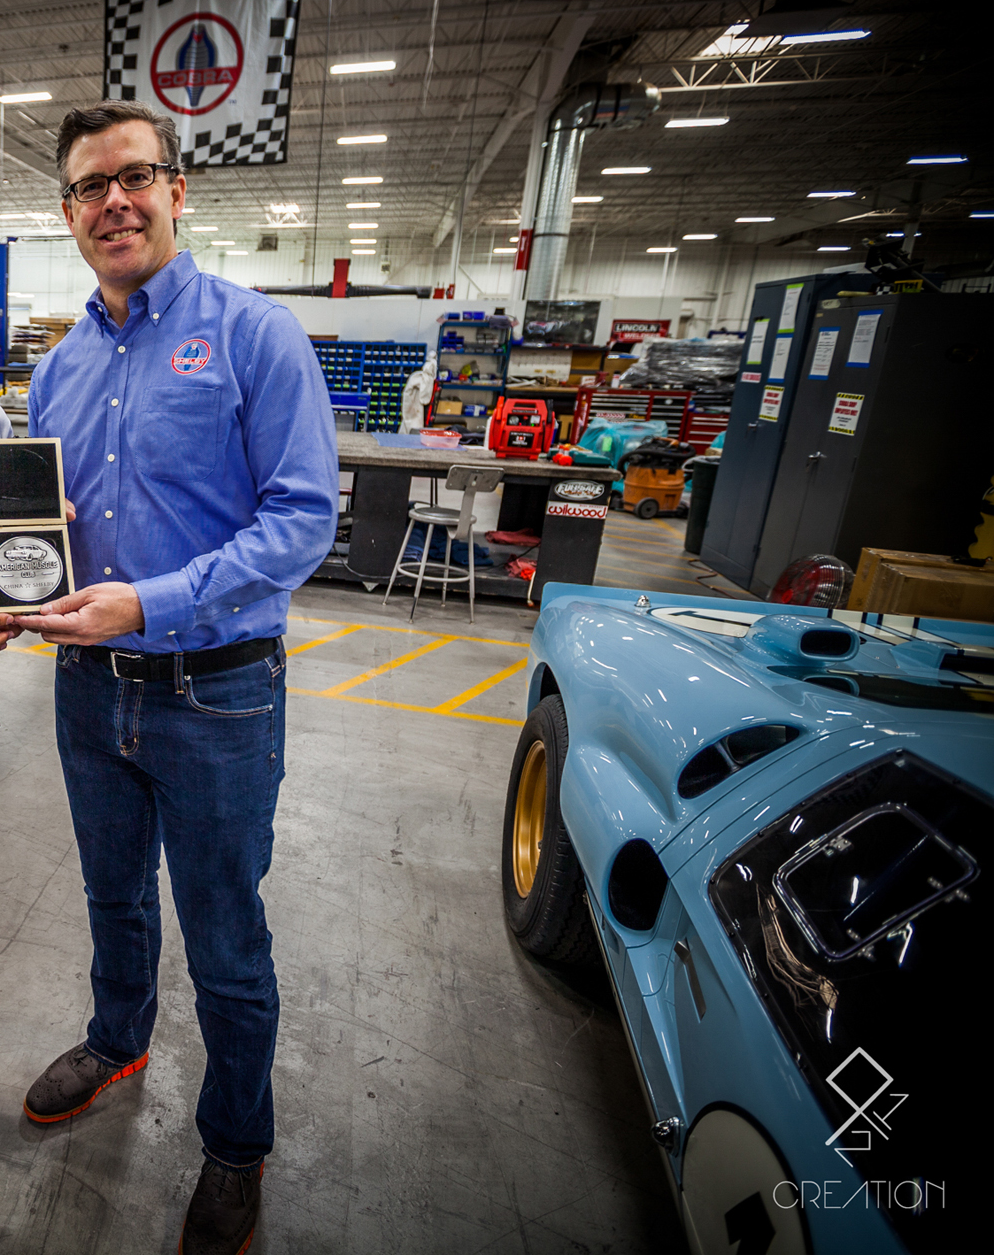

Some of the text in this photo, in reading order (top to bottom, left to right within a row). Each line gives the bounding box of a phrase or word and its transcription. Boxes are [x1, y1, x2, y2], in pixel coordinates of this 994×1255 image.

[157, 69, 233, 87] COBRA
[615, 323, 658, 332] LINCOLN
[548, 503, 606, 518] wilwood
[32, 561, 59, 571] MUSCLE
